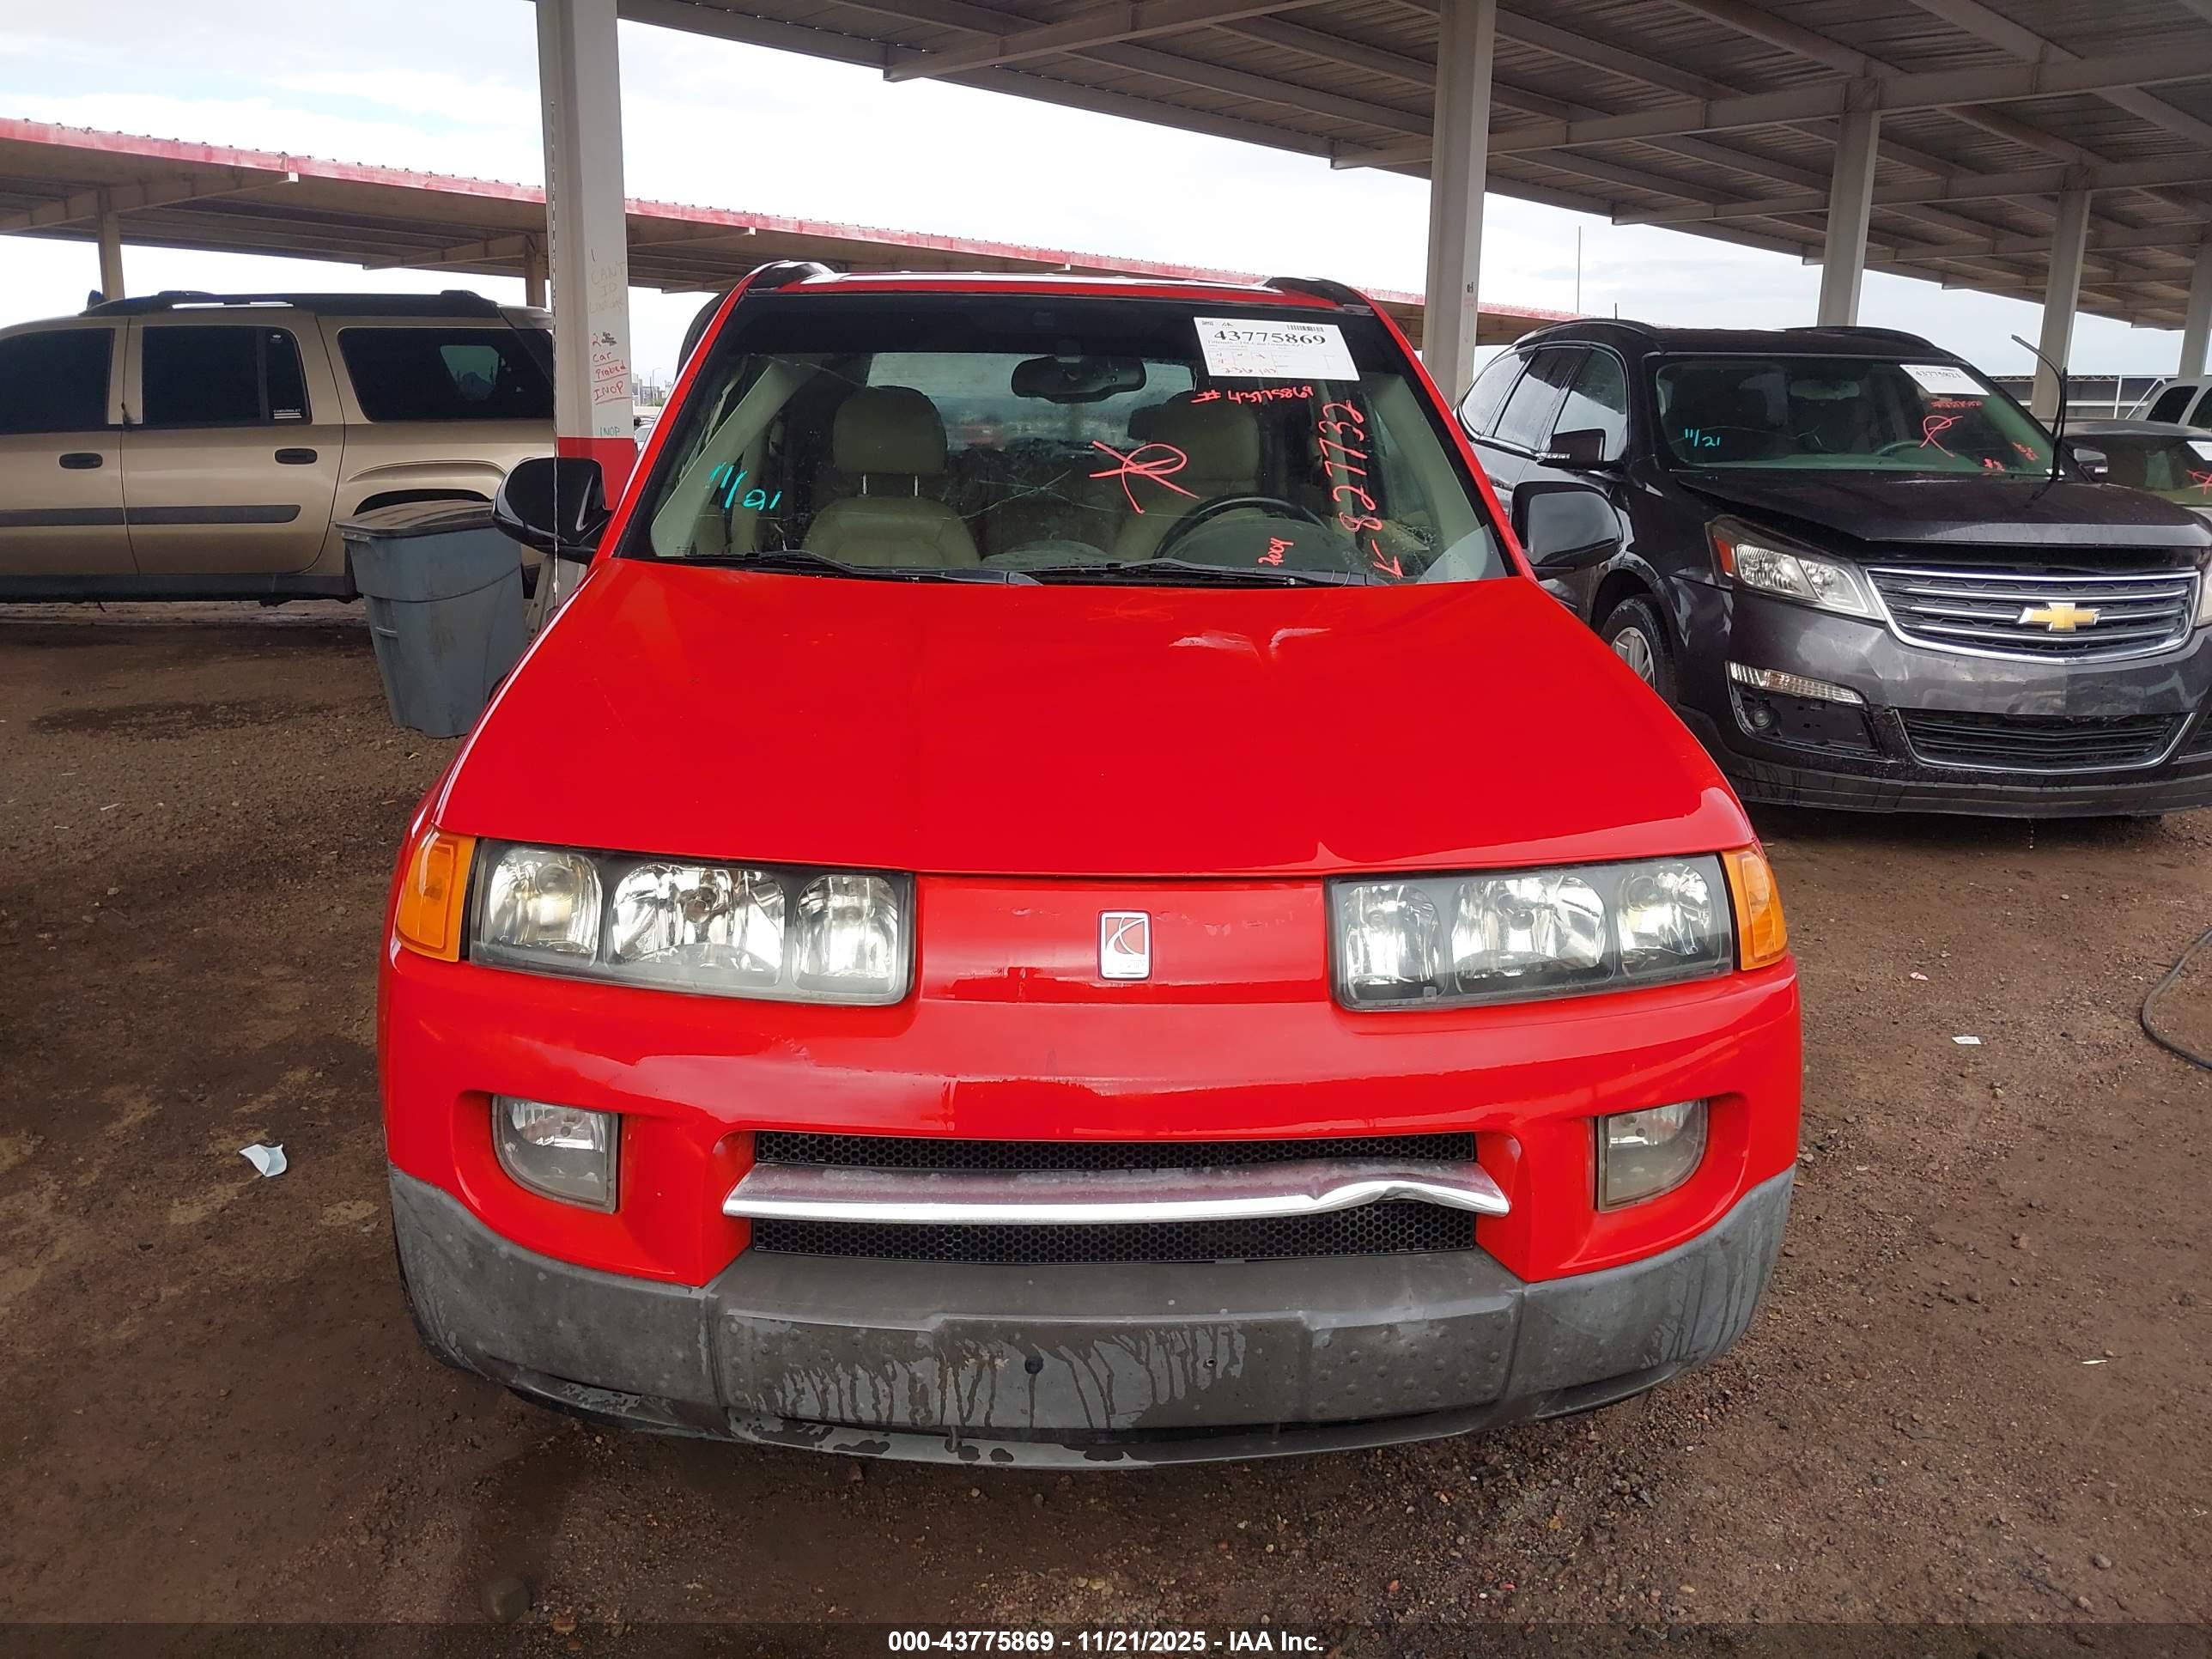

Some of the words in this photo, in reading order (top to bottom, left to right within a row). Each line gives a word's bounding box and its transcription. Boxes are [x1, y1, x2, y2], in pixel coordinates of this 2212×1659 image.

[1214, 330, 1326, 345] 43775869
[592, 351, 611, 362] Car
[593, 380, 623, 401] INOP
[1227, 386, 1314, 404] 43775869
[1685, 428, 1721, 447] 11/21
